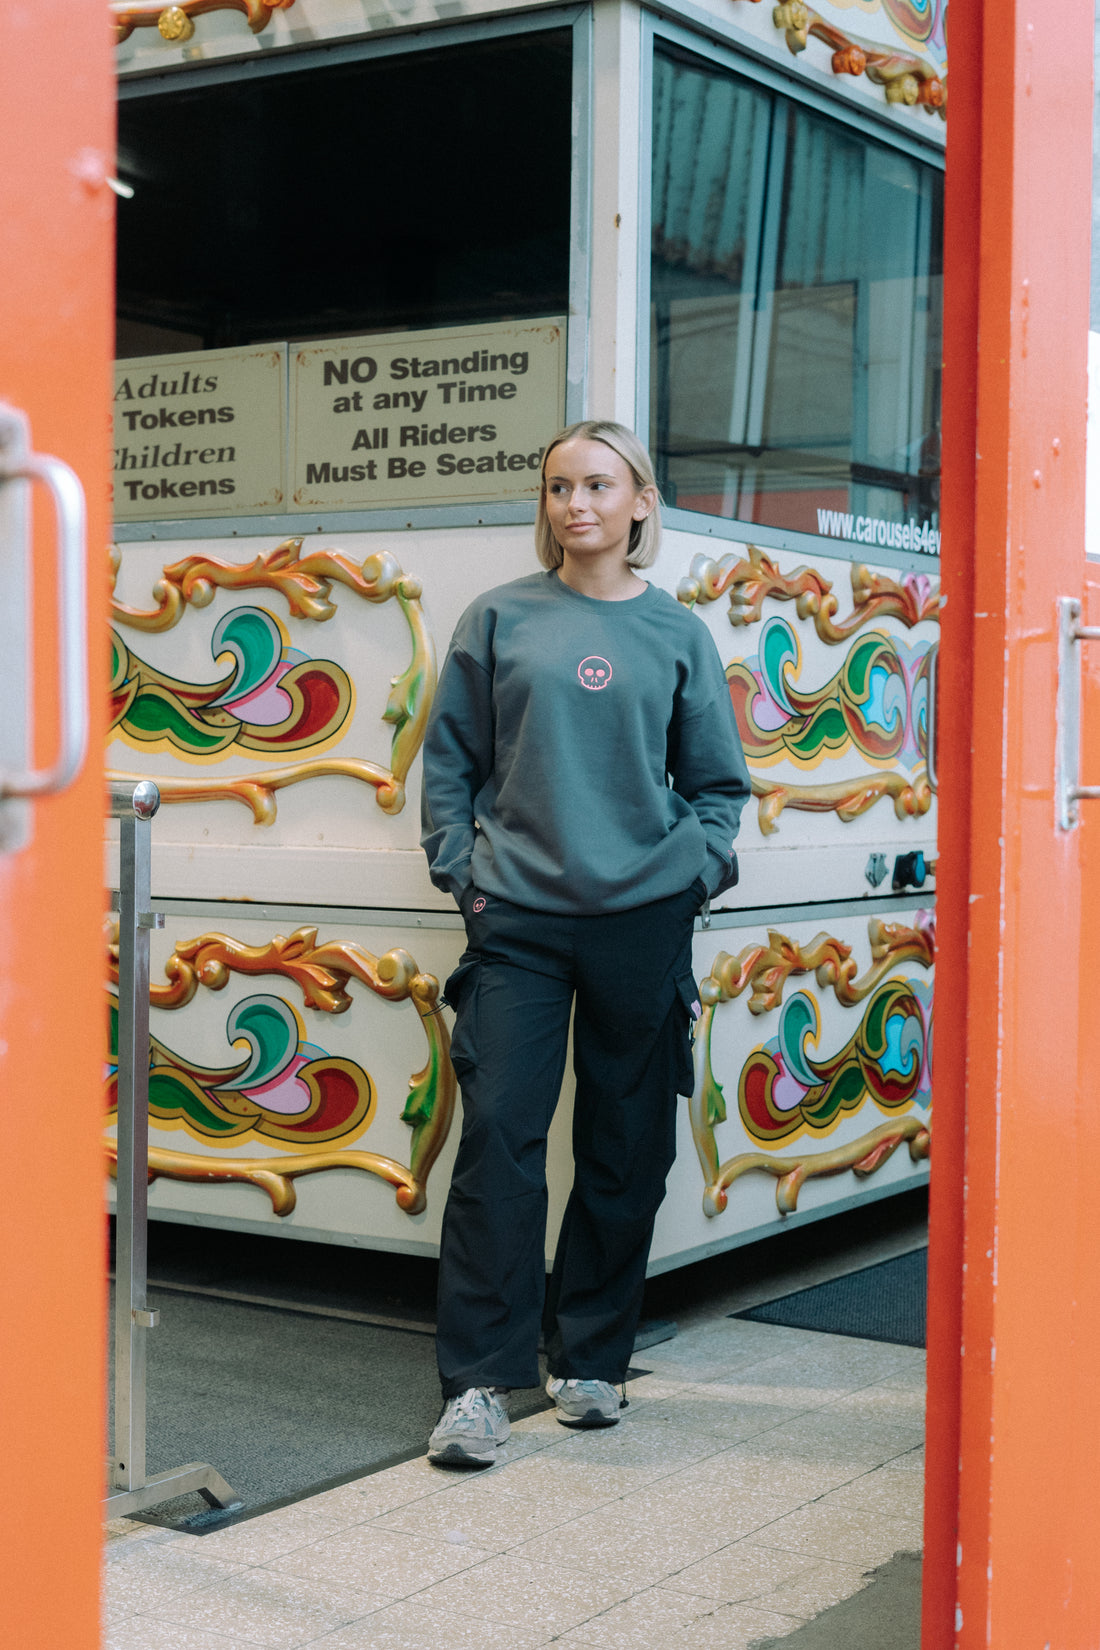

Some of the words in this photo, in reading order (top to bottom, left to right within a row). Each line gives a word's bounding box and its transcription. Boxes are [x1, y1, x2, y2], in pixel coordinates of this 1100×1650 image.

[323, 356, 377, 386] NO
[390, 349, 529, 380] Standing
[114, 370, 219, 401] Adults
[333, 391, 363, 413] at
[373, 390, 428, 413] any
[437, 381, 517, 404] Time
[122, 406, 235, 431] Tokens
[351, 427, 389, 451] All
[400, 423, 497, 448] Riders
[306, 459, 377, 484] Must
[387, 457, 426, 479] Be
[436, 447, 546, 476] Seated
[123, 478, 236, 501] Tokens
